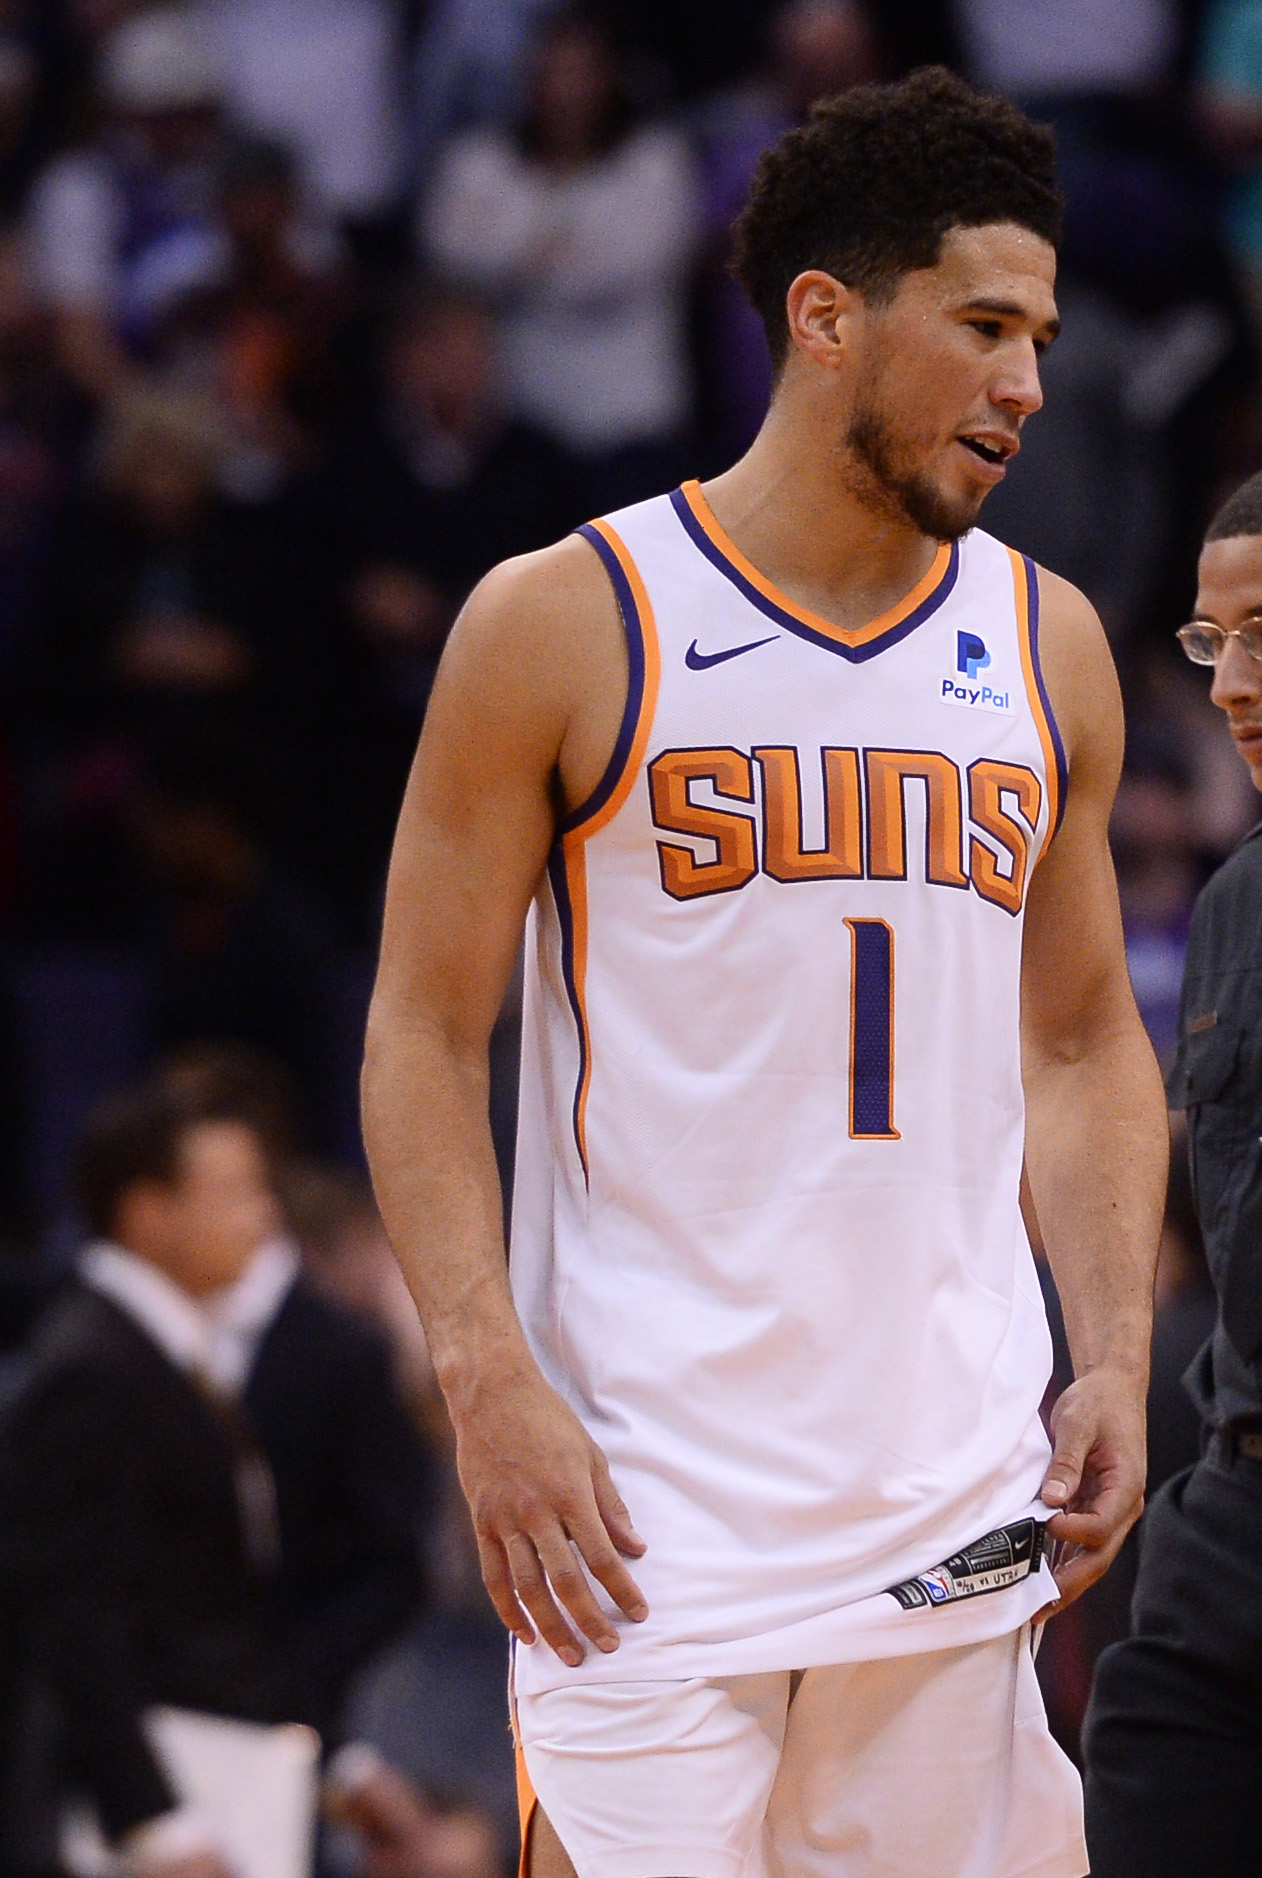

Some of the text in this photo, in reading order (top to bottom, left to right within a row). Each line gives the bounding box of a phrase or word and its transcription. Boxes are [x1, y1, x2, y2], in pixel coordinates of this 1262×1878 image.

[941, 679, 1009, 708] PayPal
[647, 745, 1042, 917] SUNS
[842, 916, 902, 1140] 1
